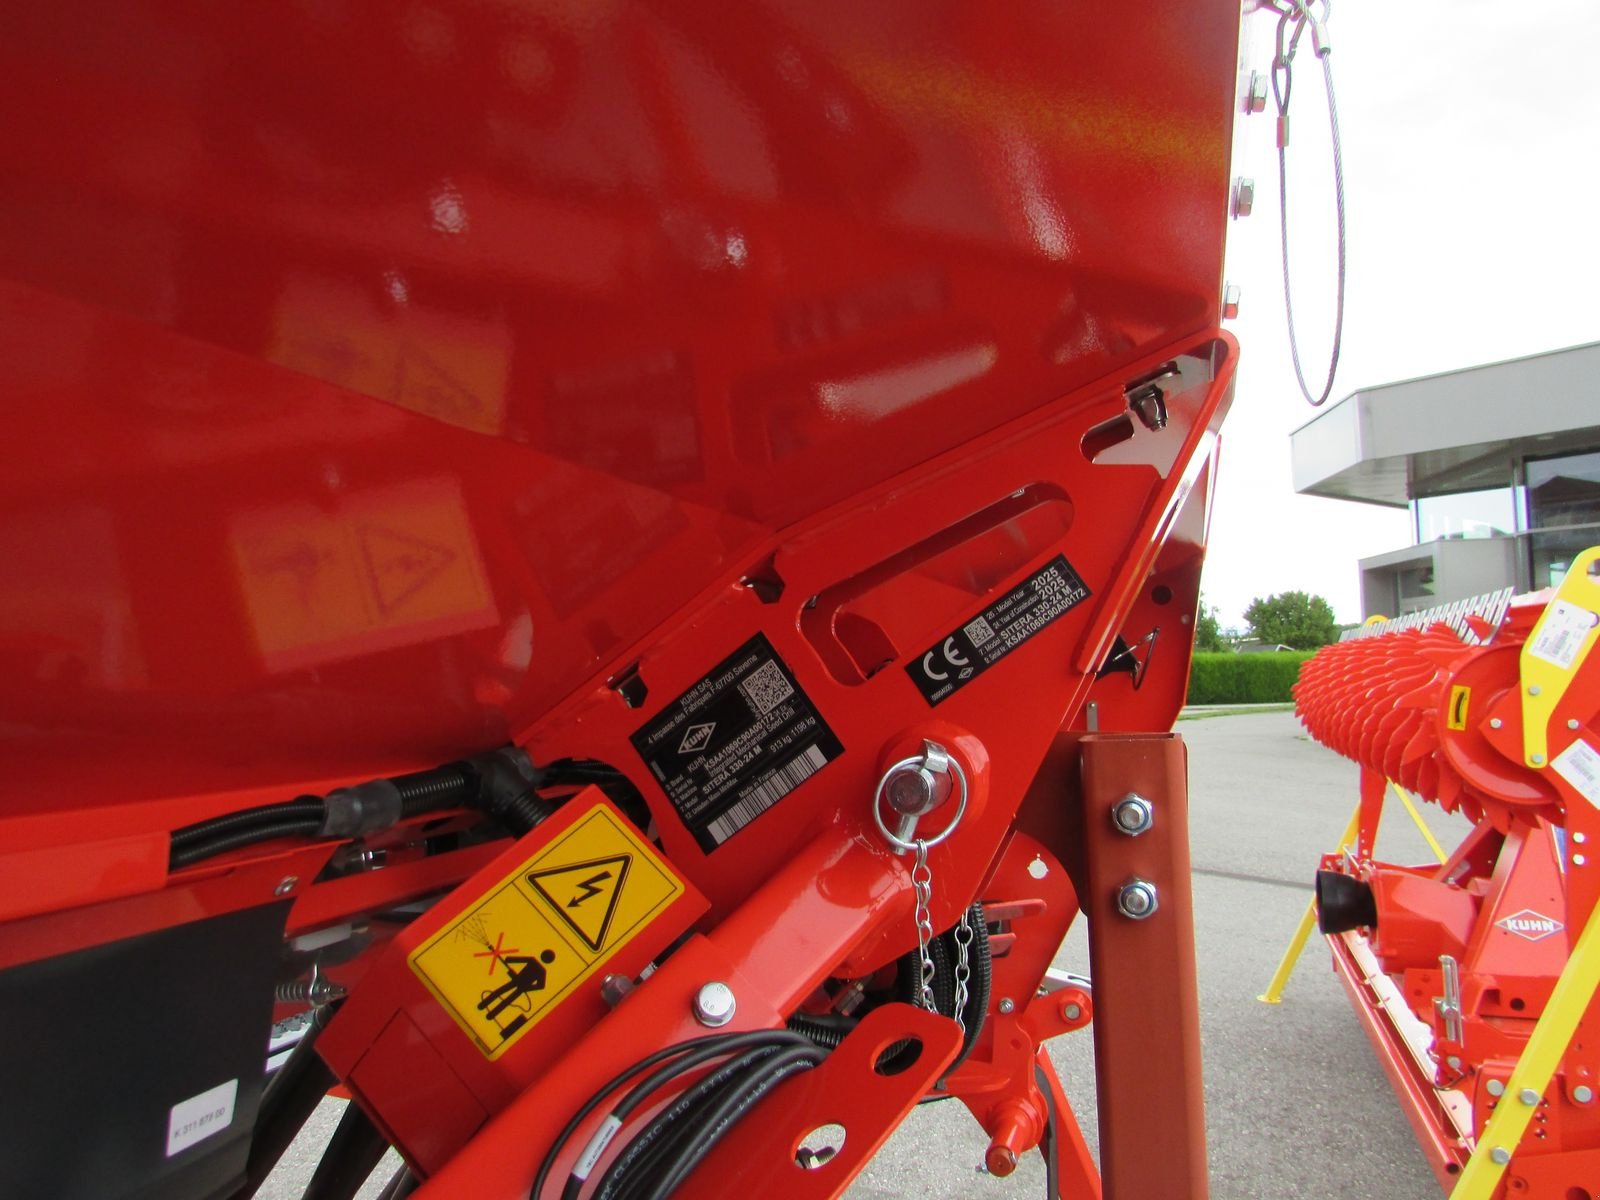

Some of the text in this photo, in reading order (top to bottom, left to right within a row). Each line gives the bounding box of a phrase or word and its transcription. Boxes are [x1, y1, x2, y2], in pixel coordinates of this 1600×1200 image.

[995, 598, 1012, 612] Model
[1010, 588, 1025, 602] Year
[1030, 566, 1059, 591] 2025
[1037, 575, 1066, 600] 2025
[983, 636, 1001, 651] Model
[999, 611, 1034, 639] SITERA
[1031, 591, 1063, 616] 330-24
[1061, 585, 1072, 596] M
[673, 711, 685, 723] des
[682, 690, 713, 715] Fabriques
[732, 653, 758, 675] Saverne
[679, 678, 712, 706] KUHN SAS
[682, 725, 712, 750] KUHN
[707, 752, 737, 777] Integrated
[733, 727, 768, 756] Mechanical
[765, 716, 783, 731] Seed
[780, 706, 795, 720] Drill
[769, 739, 784, 753] 913
[781, 733, 792, 745] kg
[804, 715, 816, 726] kg
[686, 754, 706, 772] KUHN
[701, 769, 731, 794] SITERA
[728, 751, 754, 773] 330-24
[752, 745, 762, 755] M
[757, 766, 776, 783] France
[1507, 919, 1555, 932] KUHN
